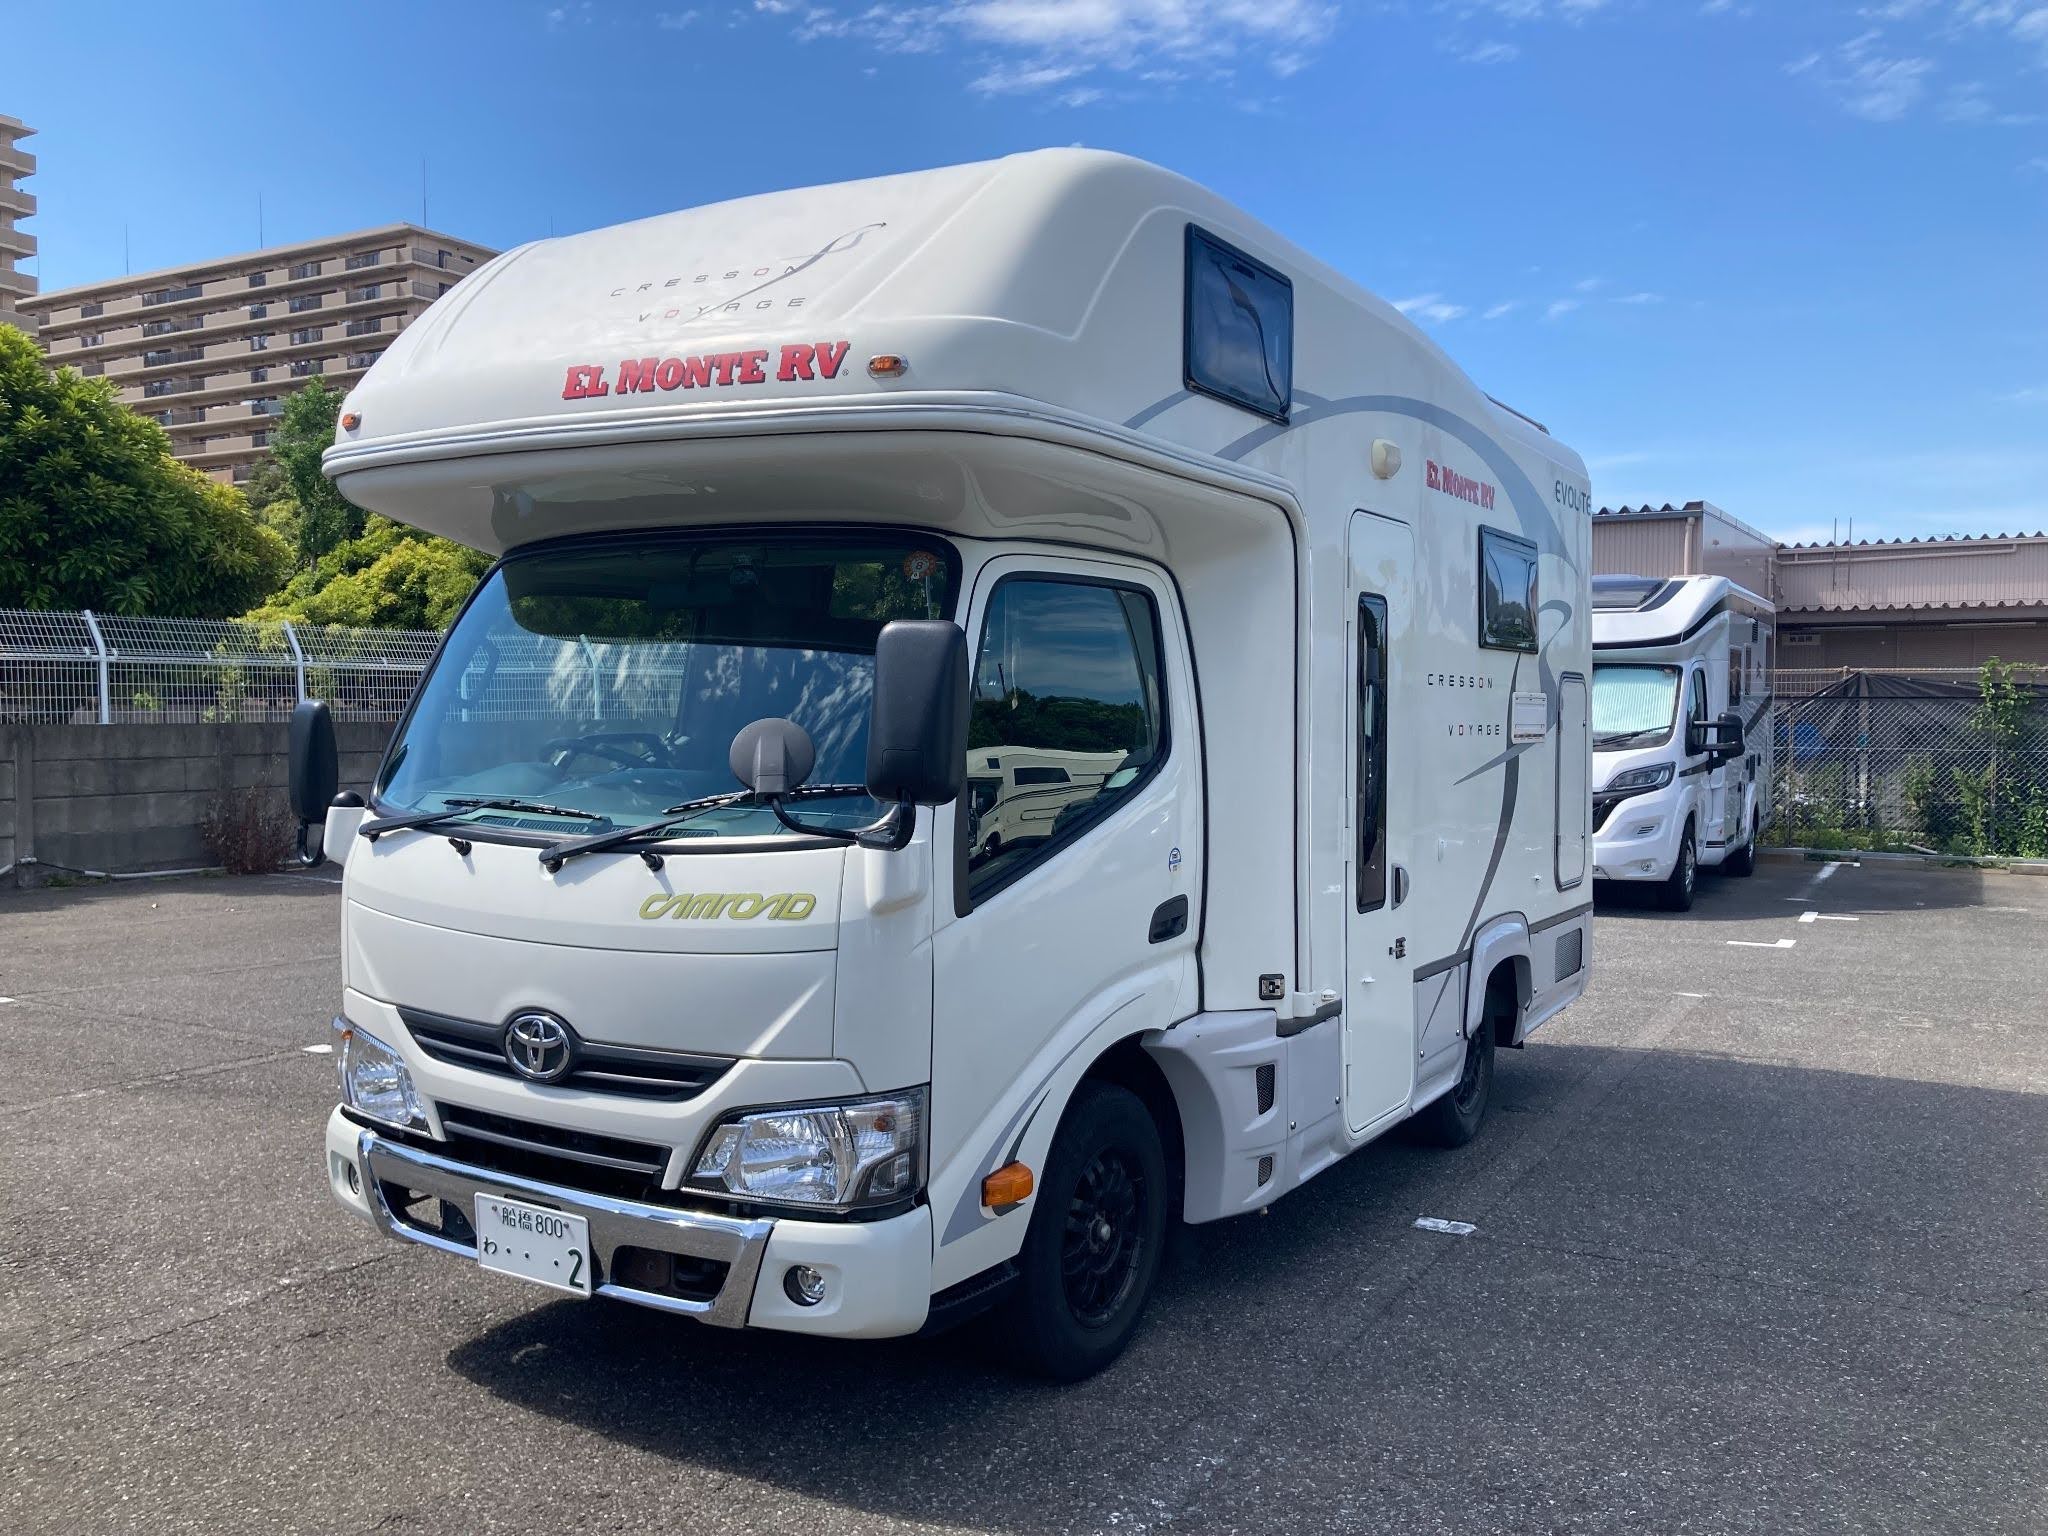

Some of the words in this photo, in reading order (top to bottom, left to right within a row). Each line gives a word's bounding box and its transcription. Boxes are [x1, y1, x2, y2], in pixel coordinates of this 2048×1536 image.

[638, 297, 806, 323] VOYAGE
[562, 365, 608, 399] EL
[616, 350, 769, 394] MONTE
[1426, 459, 1441, 491] EL
[1442, 465, 1479, 505] MONTE
[1427, 673, 1493, 689] CRESSON
[1448, 724, 1500, 736] VOYAGE
[483, 1236, 498, 1255] わ
